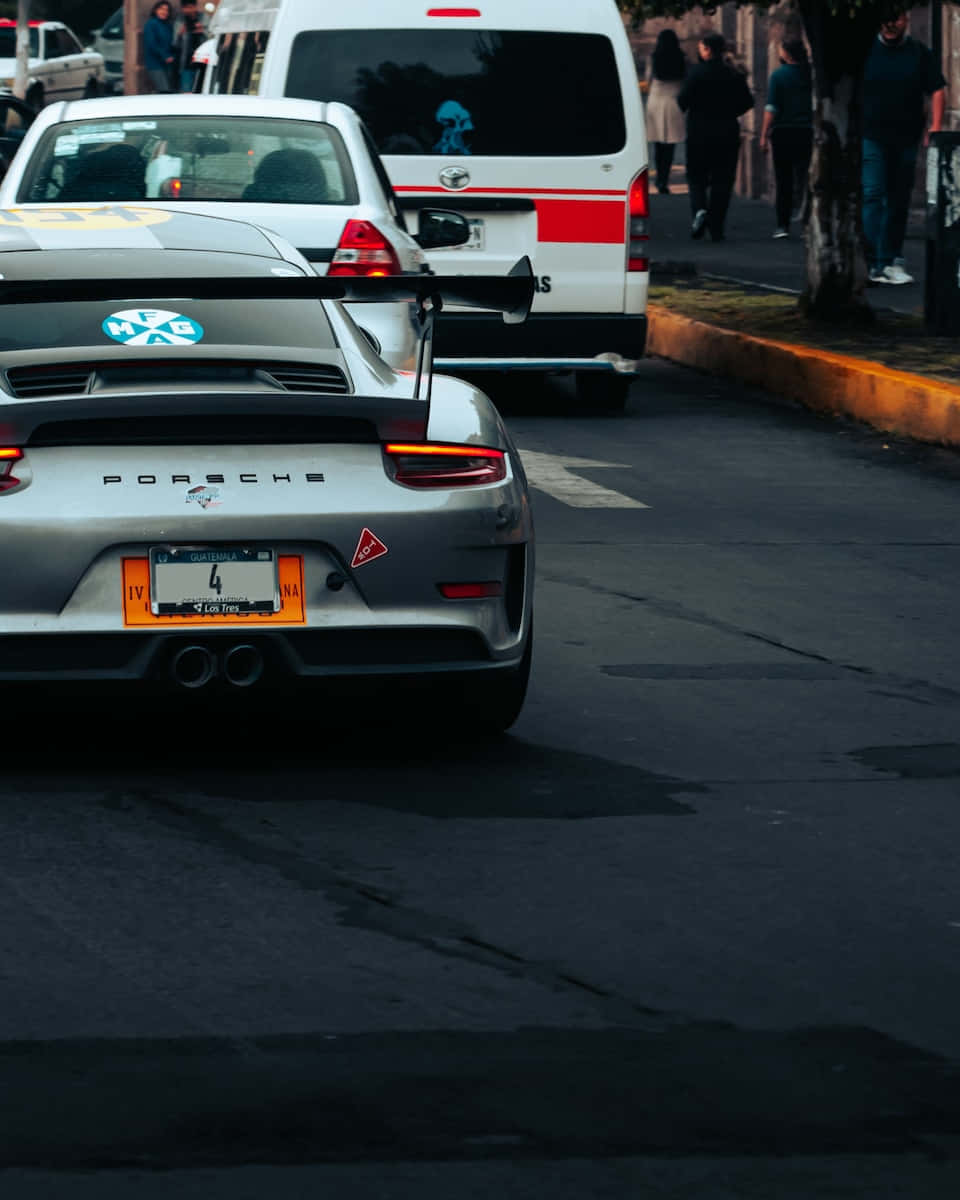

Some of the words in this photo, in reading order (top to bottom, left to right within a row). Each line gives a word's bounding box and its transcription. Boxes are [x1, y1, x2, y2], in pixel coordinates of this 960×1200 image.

[103, 473, 325, 486] PORSCHE
[190, 551, 238, 562] GUATEMALA
[208, 563, 223, 595] 4
[204, 603, 220, 613] Los
[222, 603, 240, 613] Tres
